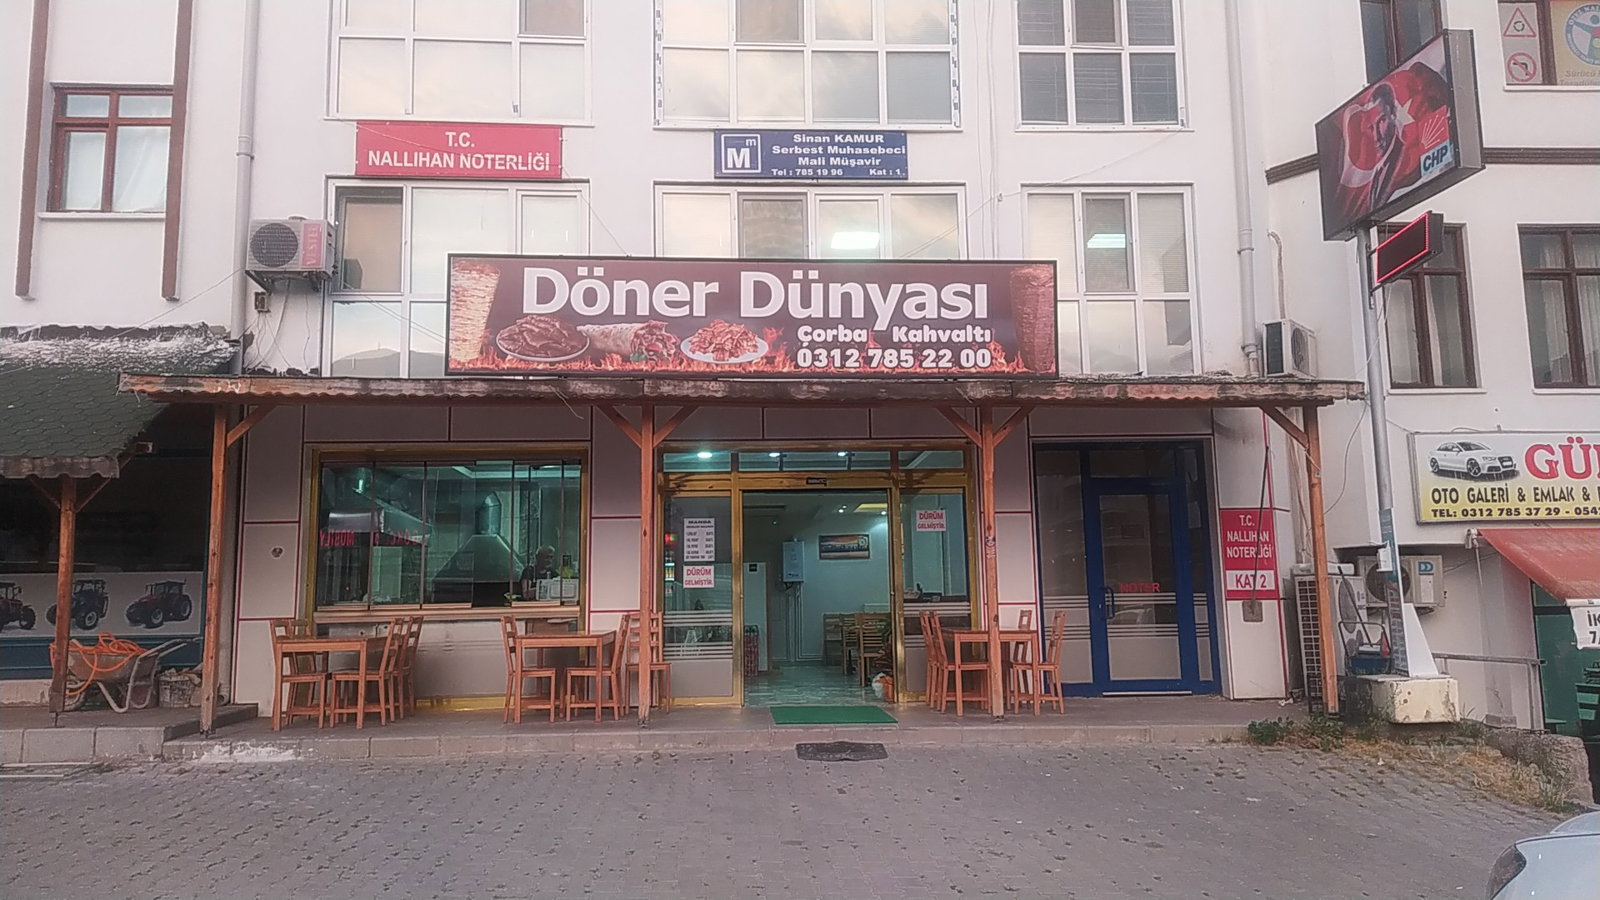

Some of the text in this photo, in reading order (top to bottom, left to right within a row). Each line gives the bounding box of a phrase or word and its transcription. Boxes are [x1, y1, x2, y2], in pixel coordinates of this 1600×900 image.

[445, 131, 475, 148] T.C.
[793, 134, 885, 144] Sinan KAMUR
[772, 145, 906, 155] Serbest Muhasebeci
[368, 150, 550, 172] NALLIHAN NOTERLİĞİ
[798, 156, 882, 168] Mali Müşavir
[1423, 144, 1448, 172] CHP
[771, 168, 787, 176] Tel
[795, 168, 814, 176] 785
[816, 168, 828, 176] 19
[829, 168, 844, 176] 96
[869, 168, 886, 176] Kat
[522, 266, 988, 331] Döner Dünyası
[797, 325, 991, 348] Çorba Kahvaltı
[797, 349, 991, 368] 0312 785 22 00
[1431, 487, 1459, 504] OTO
[1467, 483, 1509, 504] GALERİ
[1533, 486, 1575, 503] EMLAK
[920, 511, 943, 519] DÜRÜM
[1431, 509, 1457, 518] TEL:
[1461, 508, 1493, 517] 0312
[1497, 507, 1521, 517] 785
[1525, 507, 1541, 516] 37
[1545, 507, 1560, 516] 29
[1239, 514, 1255, 526] T.C.
[1227, 530, 1269, 542] NALLIHAN
[686, 568, 711, 576] DÜRÜM
[1260, 574, 1267, 588] 2
